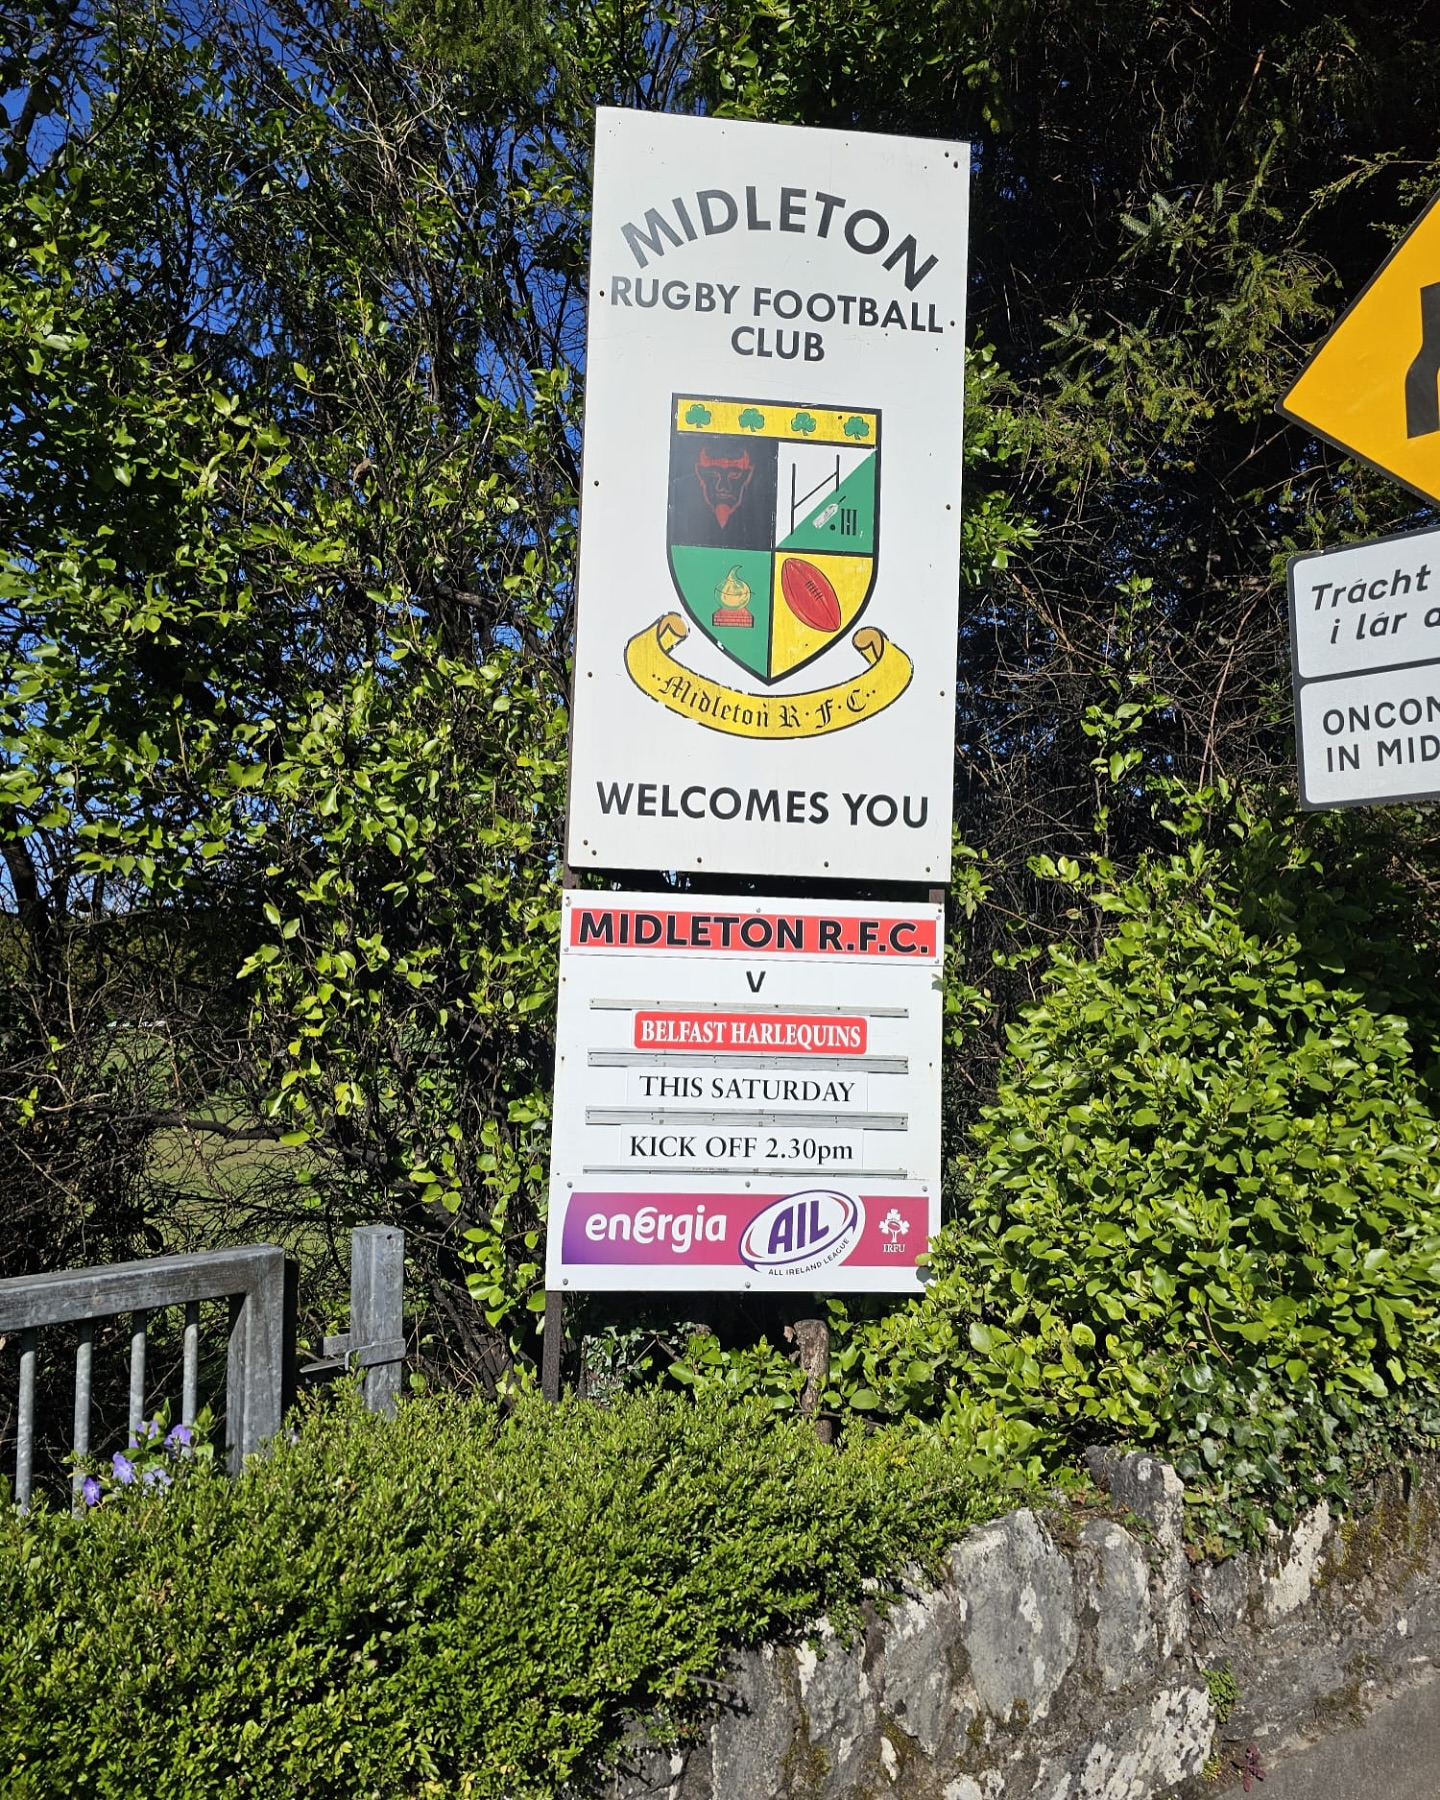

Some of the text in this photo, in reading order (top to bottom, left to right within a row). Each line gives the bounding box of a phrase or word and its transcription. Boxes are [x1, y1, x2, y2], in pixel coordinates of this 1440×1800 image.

[620, 186, 939, 292] MIDLETON
[611, 276, 944, 334] RUGBY FOOTBALL
[731, 326, 825, 362] CLUB
[1311, 564, 1431, 611] Trácht
[1330, 618, 1341, 644] i
[1356, 611, 1407, 640] lár
[658, 676, 769, 728] Midleton
[1326, 734, 1440, 773] IN MID
[596, 781, 929, 829] WELCOMES YOU
[578, 911, 929, 954] MIDLETON R.F.C.
[641, 1020, 861, 1050] BELFAST HARLEQUINS
[639, 1075, 856, 1103] THIS SATURDAY
[629, 1135, 854, 1165] KICK OFF 2.30pm
[767, 1200, 830, 1254] AIL
[768, 1237, 850, 1276] ALL IRELAND LEAGUE
[883, 1243, 906, 1253] IRFU
